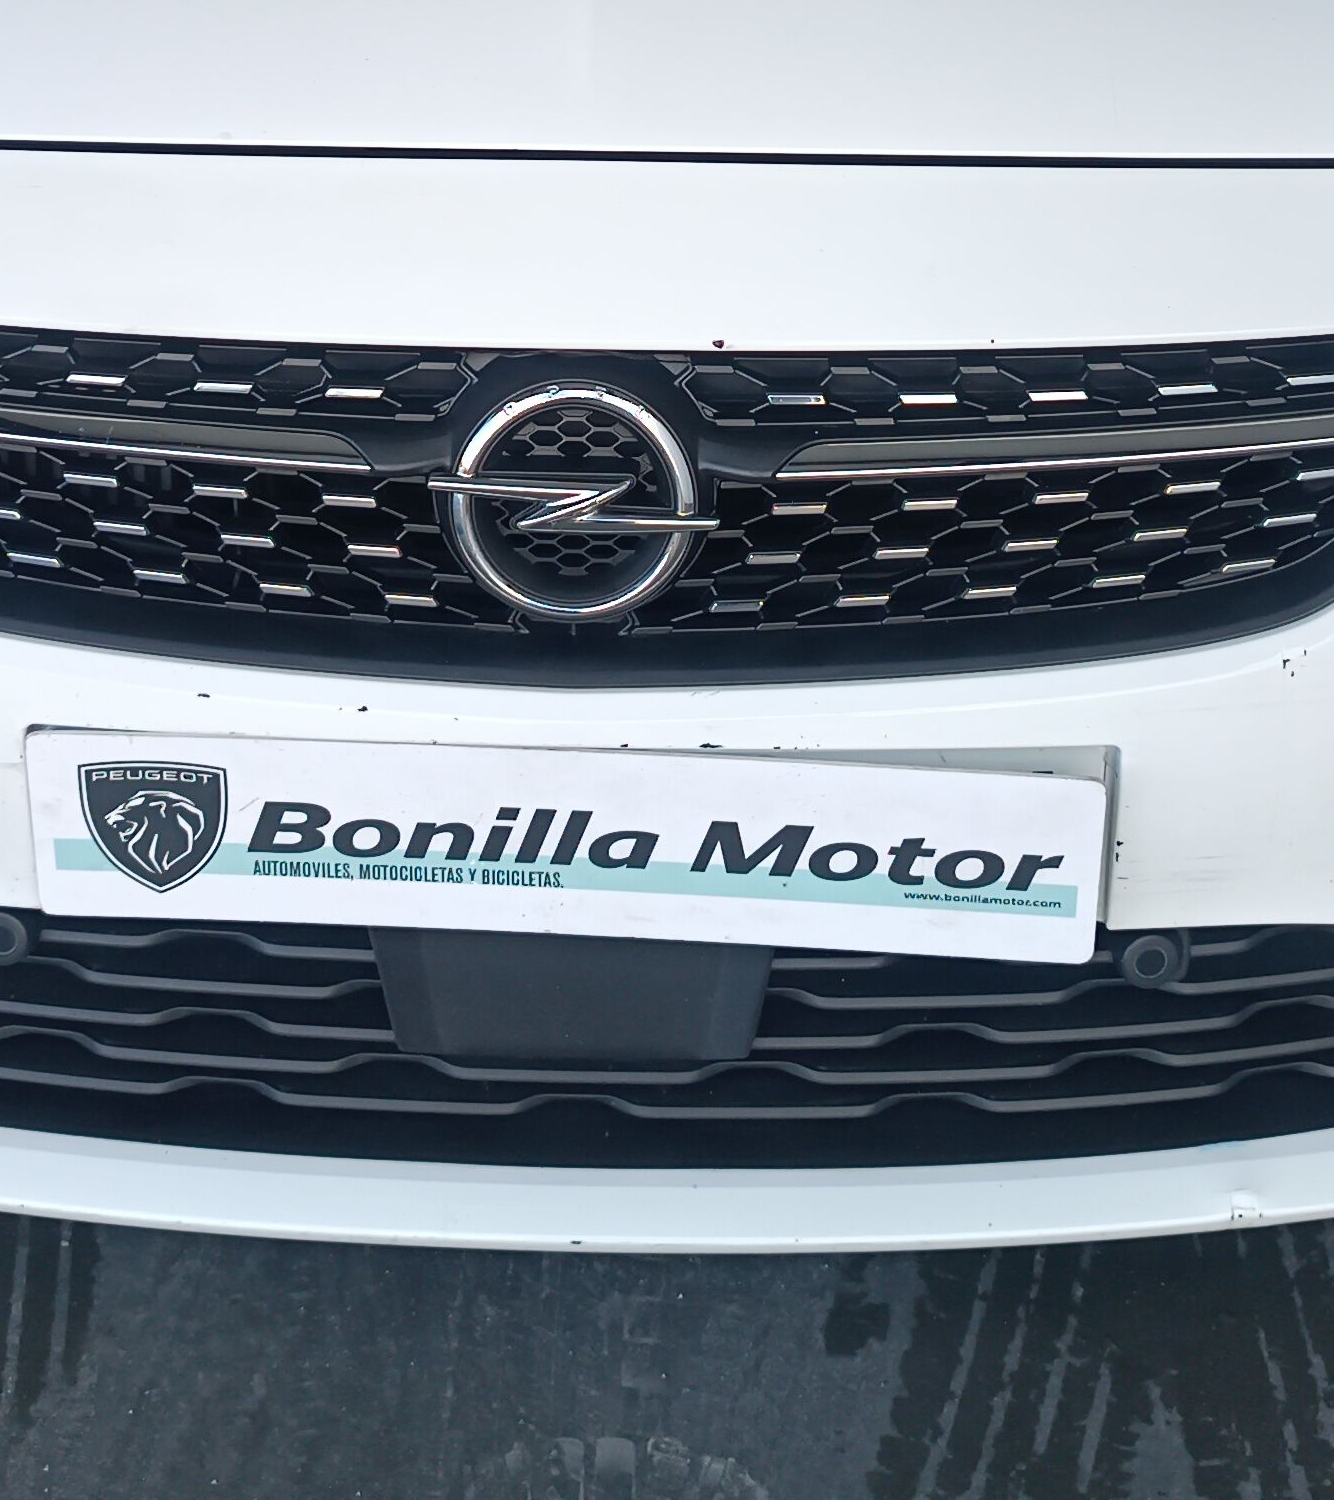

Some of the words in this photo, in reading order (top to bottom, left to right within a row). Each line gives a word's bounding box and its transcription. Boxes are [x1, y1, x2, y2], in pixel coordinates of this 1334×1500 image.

[92, 769, 213, 785] PEUGEOT
[247, 801, 659, 870] Bonilla
[689, 820, 1065, 892] Motor
[253, 860, 353, 881] AUTOMOVILES,
[359, 863, 463, 884] MOTOCICLETAS
[469, 867, 476, 884] Y
[482, 870, 564, 888] BICICLETAS.
[904, 891, 1061, 909] www.bonillamotor.com
